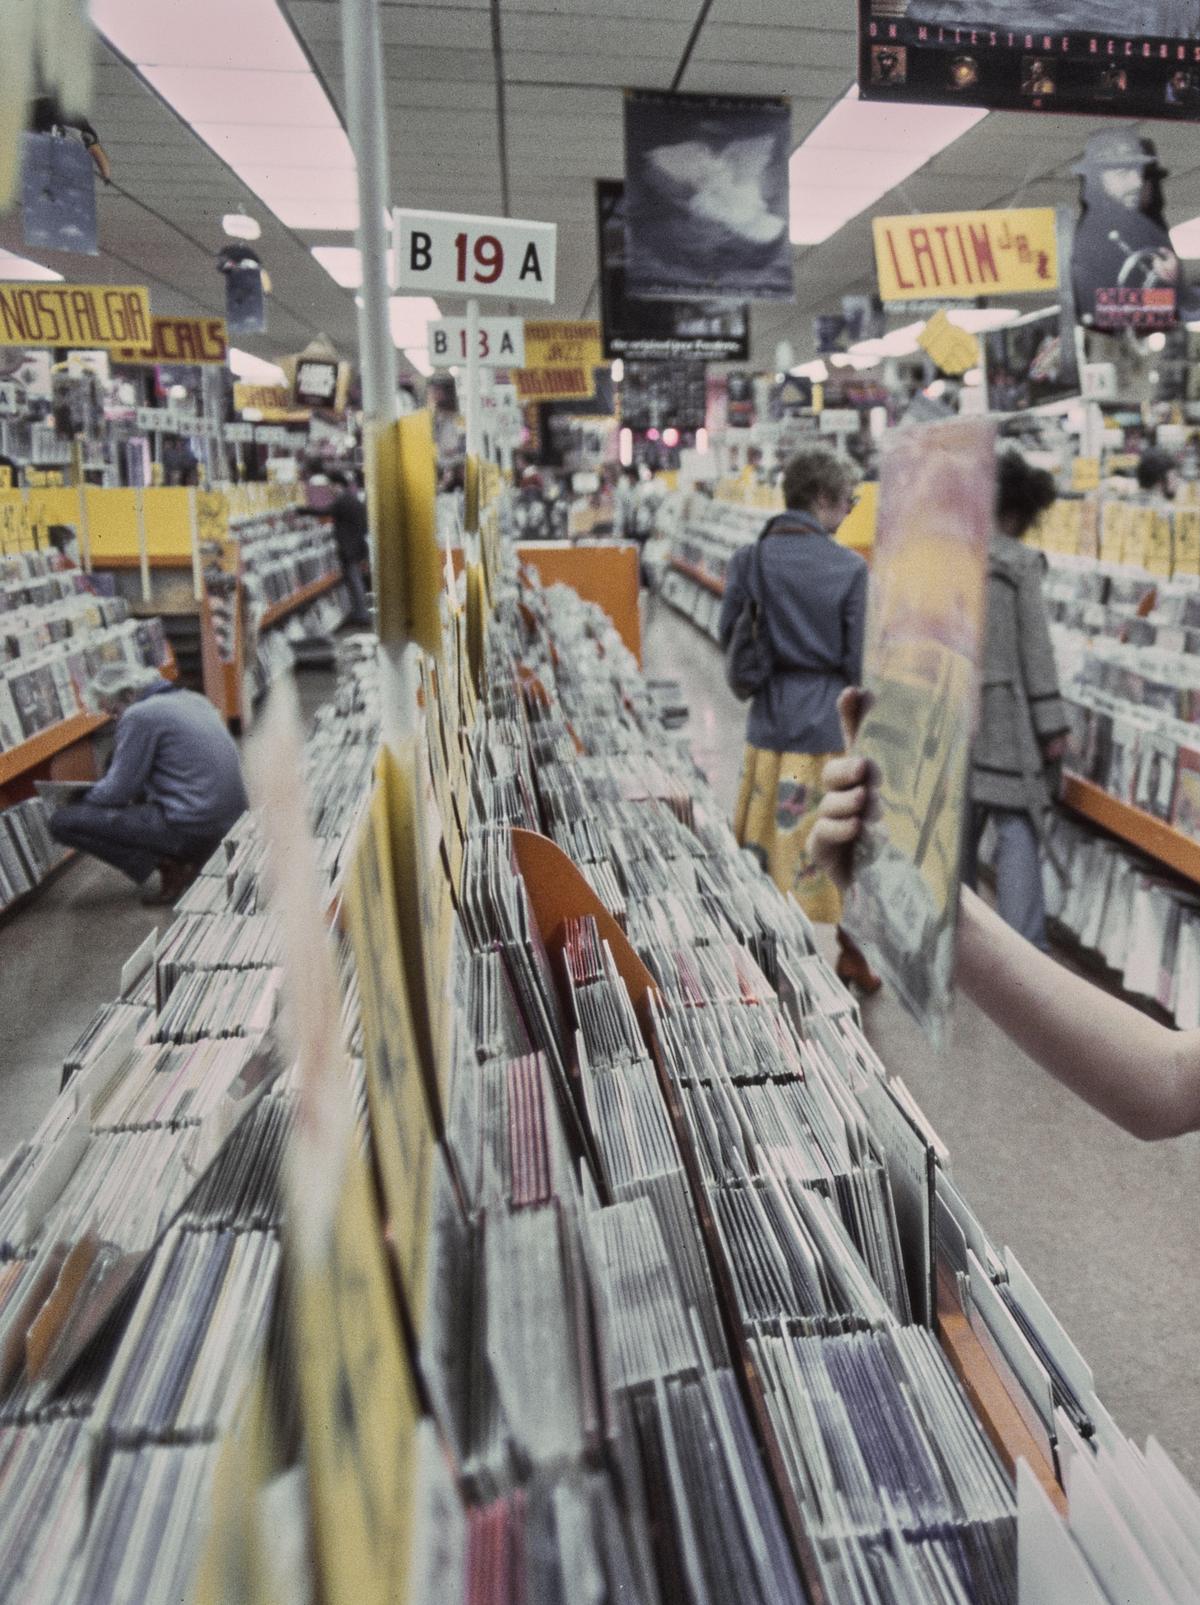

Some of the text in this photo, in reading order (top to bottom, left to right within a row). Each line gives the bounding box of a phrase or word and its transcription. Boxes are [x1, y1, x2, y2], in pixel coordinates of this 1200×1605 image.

[869, 22, 897, 39] ON
[918, 26, 1068, 52] MILESTONE
[410, 230, 543, 284] B 19 A
[886, 223, 999, 289] LATIN
[0, 288, 149, 342] NOSTALGIA
[434, 330, 448, 354] B
[500, 331, 515, 354] A
